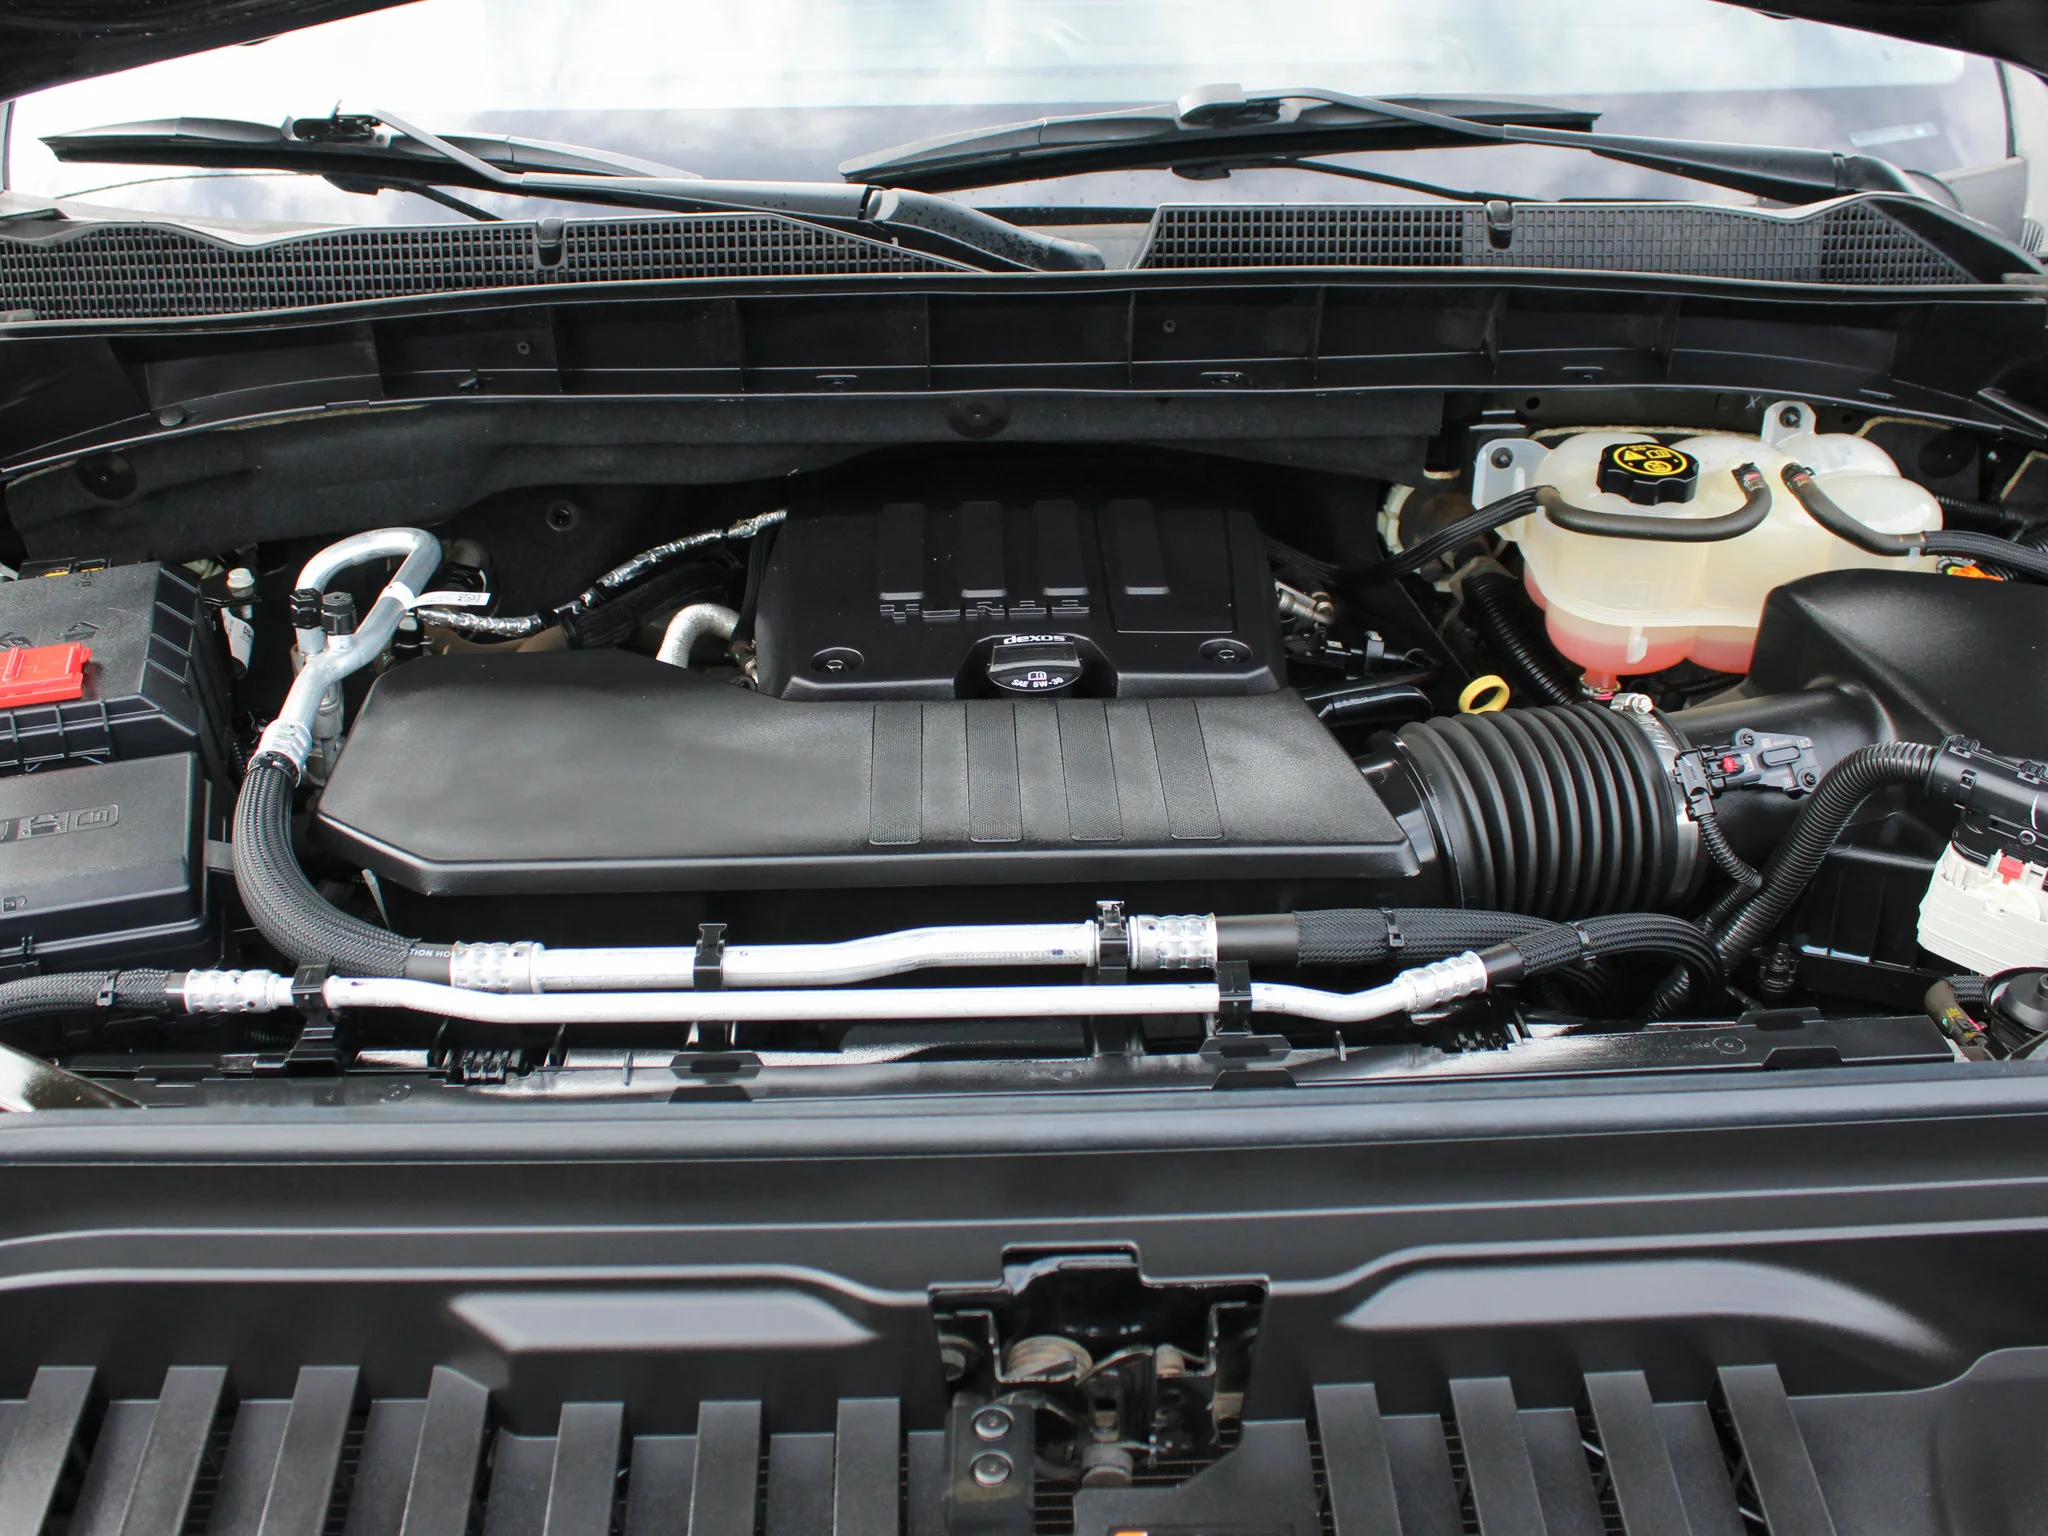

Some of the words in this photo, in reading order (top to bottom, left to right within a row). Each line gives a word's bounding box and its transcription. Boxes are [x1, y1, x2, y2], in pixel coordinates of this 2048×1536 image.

[1003, 635, 1066, 645] dexos
[1011, 679, 1030, 688] SAE
[1031, 677, 1064, 688] 5W-30
[409, 948, 434, 957] TION
